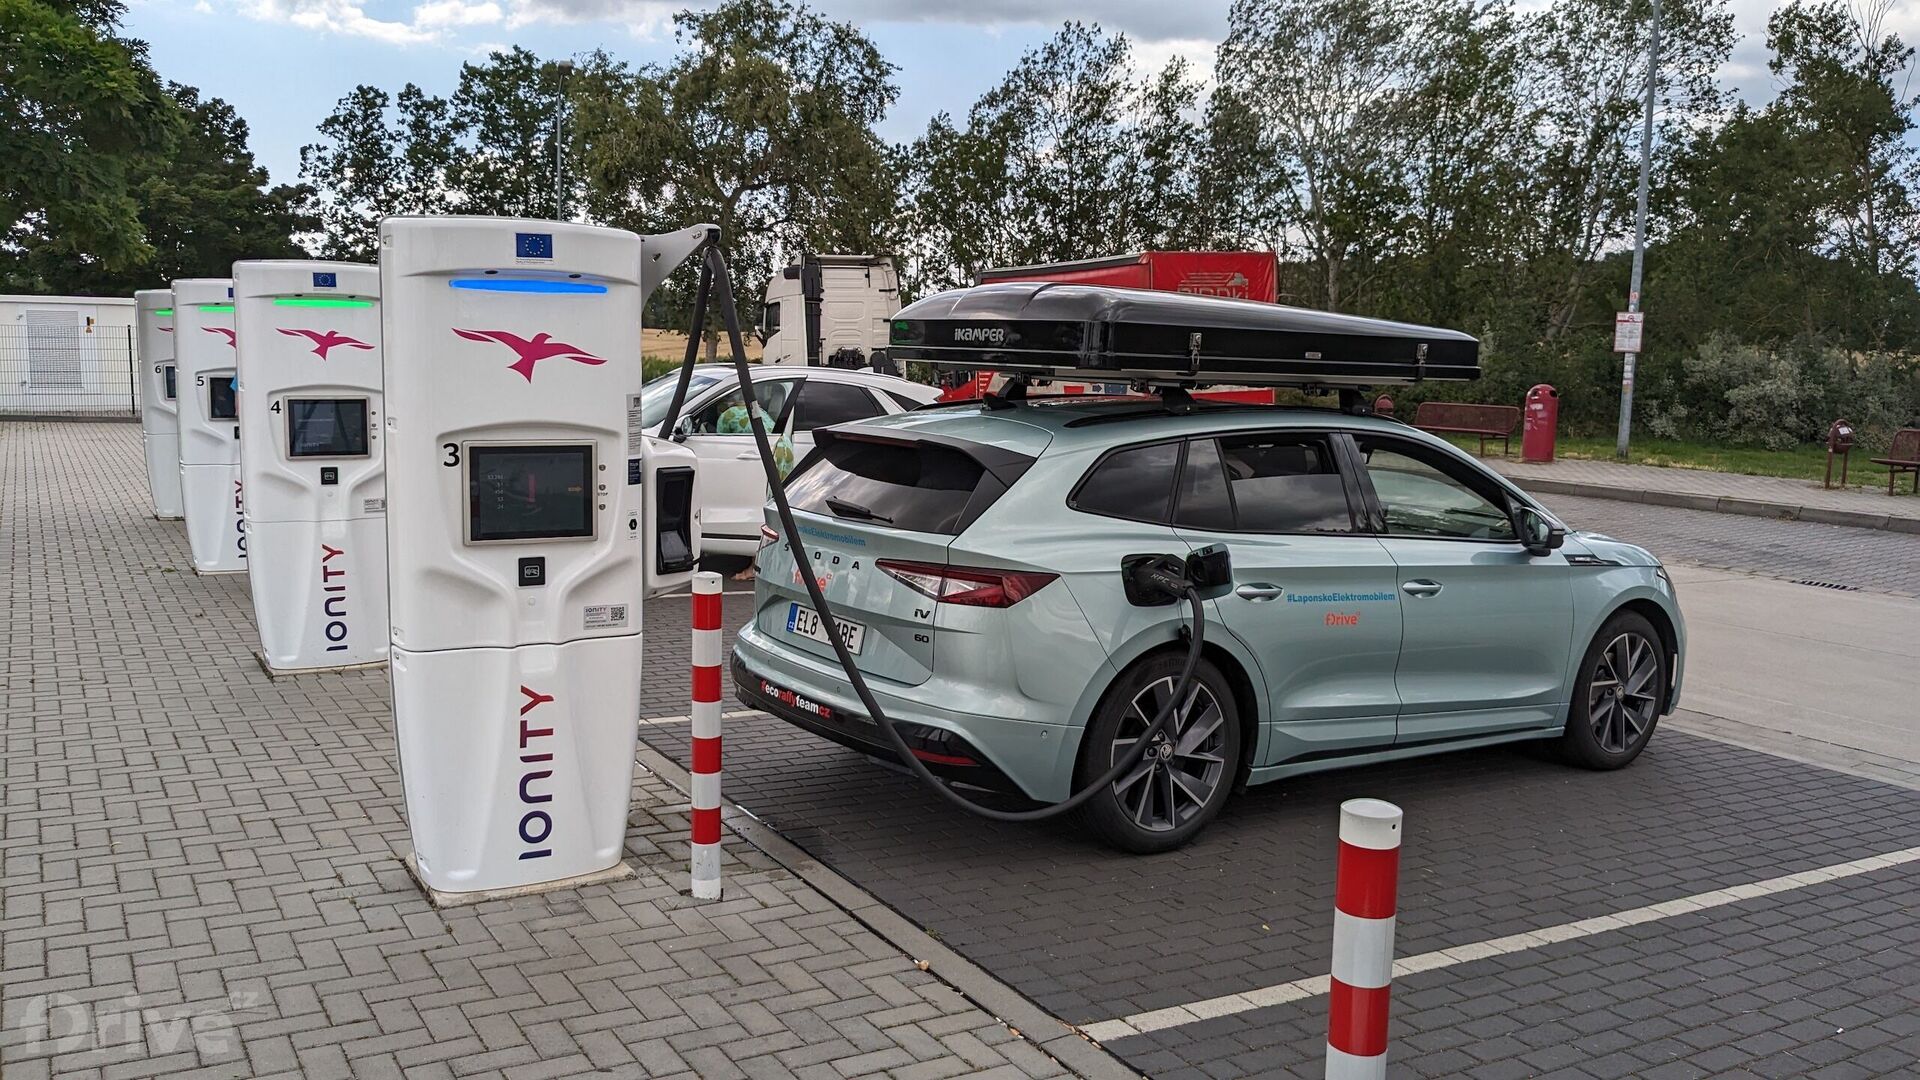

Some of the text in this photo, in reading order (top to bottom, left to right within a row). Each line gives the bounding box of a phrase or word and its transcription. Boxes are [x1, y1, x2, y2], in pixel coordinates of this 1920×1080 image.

[155, 365, 162, 374] 6
[196, 375, 205, 387] 5
[270, 400, 282, 414] 4
[443, 442, 460, 467] 3
[784, 542, 860, 570] SODA
[321, 544, 349, 652] IONITY
[914, 634, 930, 644] 60
[518, 684, 555, 861] IONITY
